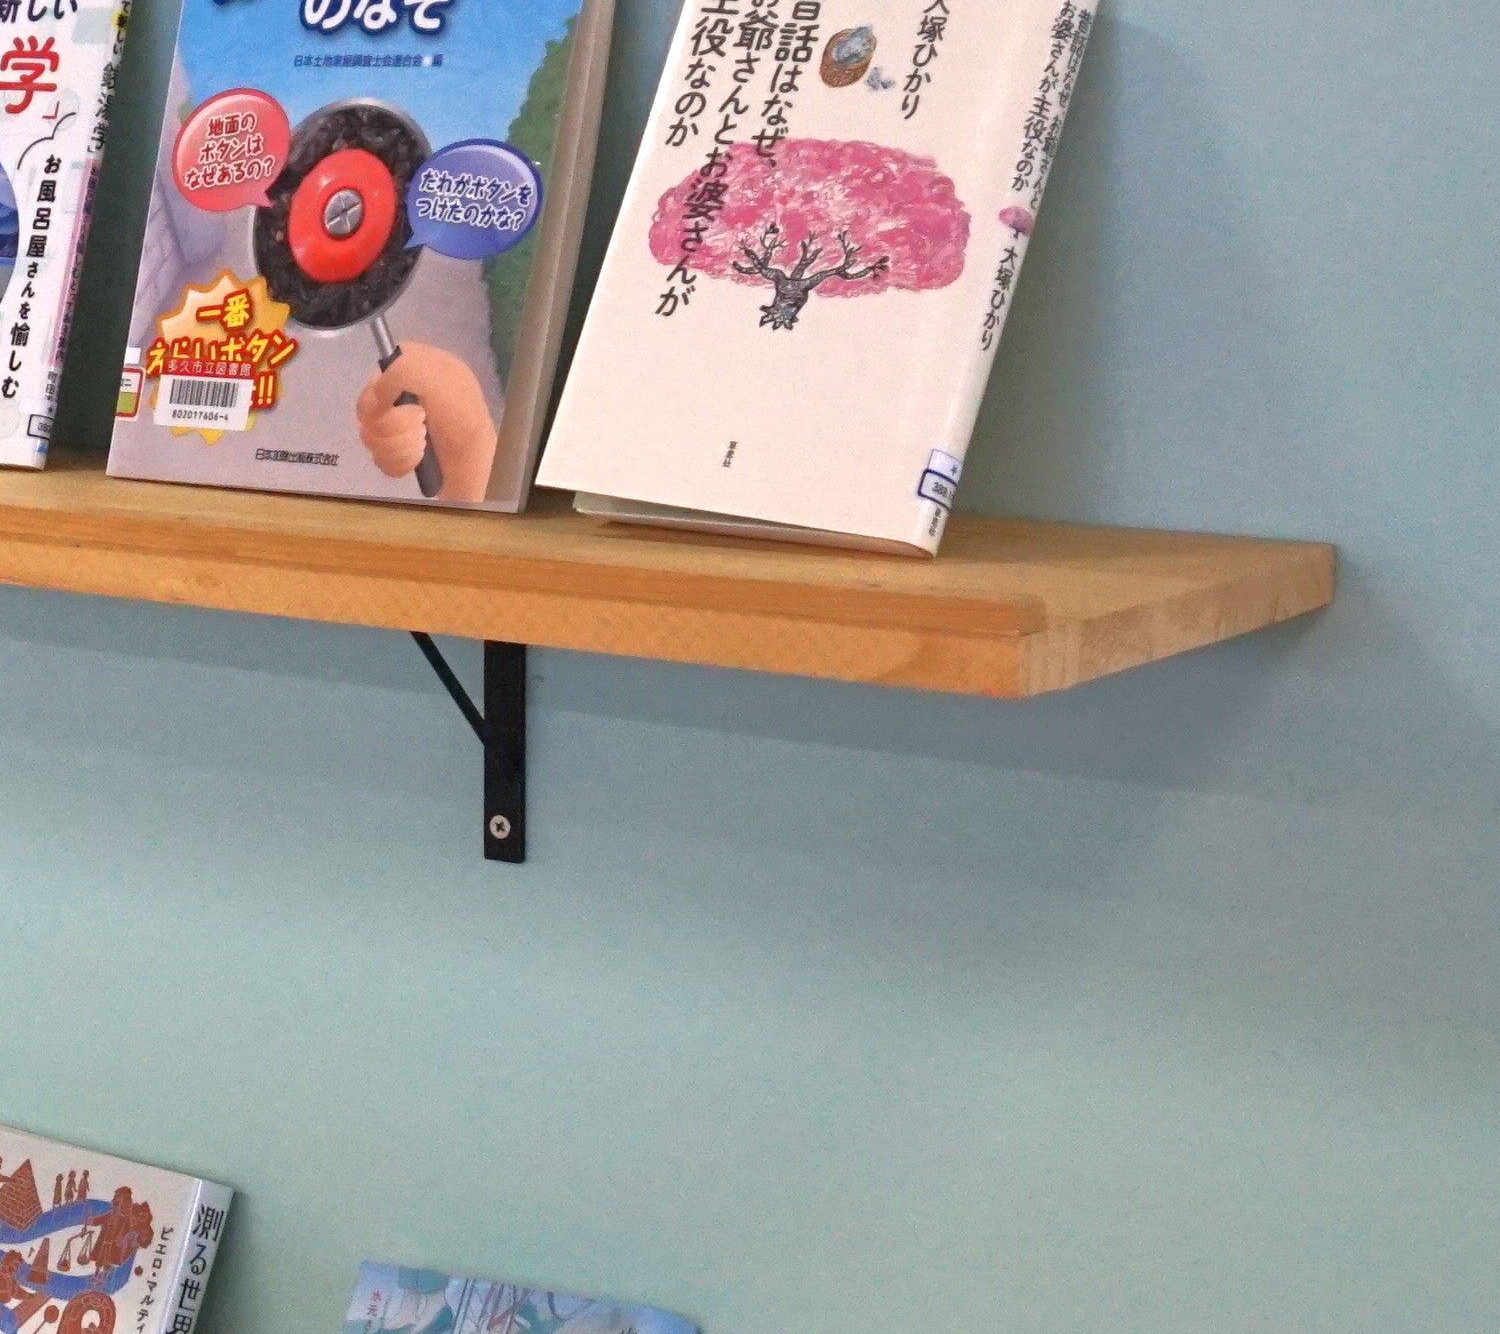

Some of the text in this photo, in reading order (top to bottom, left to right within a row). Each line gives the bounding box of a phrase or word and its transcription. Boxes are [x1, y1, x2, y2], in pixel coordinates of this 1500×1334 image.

[207, 113, 257, 138] 地面の
[199, 136, 263, 164] ボタンは
[185, 156, 275, 191] なぜあるの?
[420, 167, 533, 206] だれがボタンを
[415, 197, 526, 231] つけたのかな?
[0, 154, 62, 399] お風呂屋さんを愉しむ
[198, 291, 251, 329] 一番
[980, 246, 1019, 352] 大塚ひかり
[167, 358, 253, 377] 多久市立図書館
